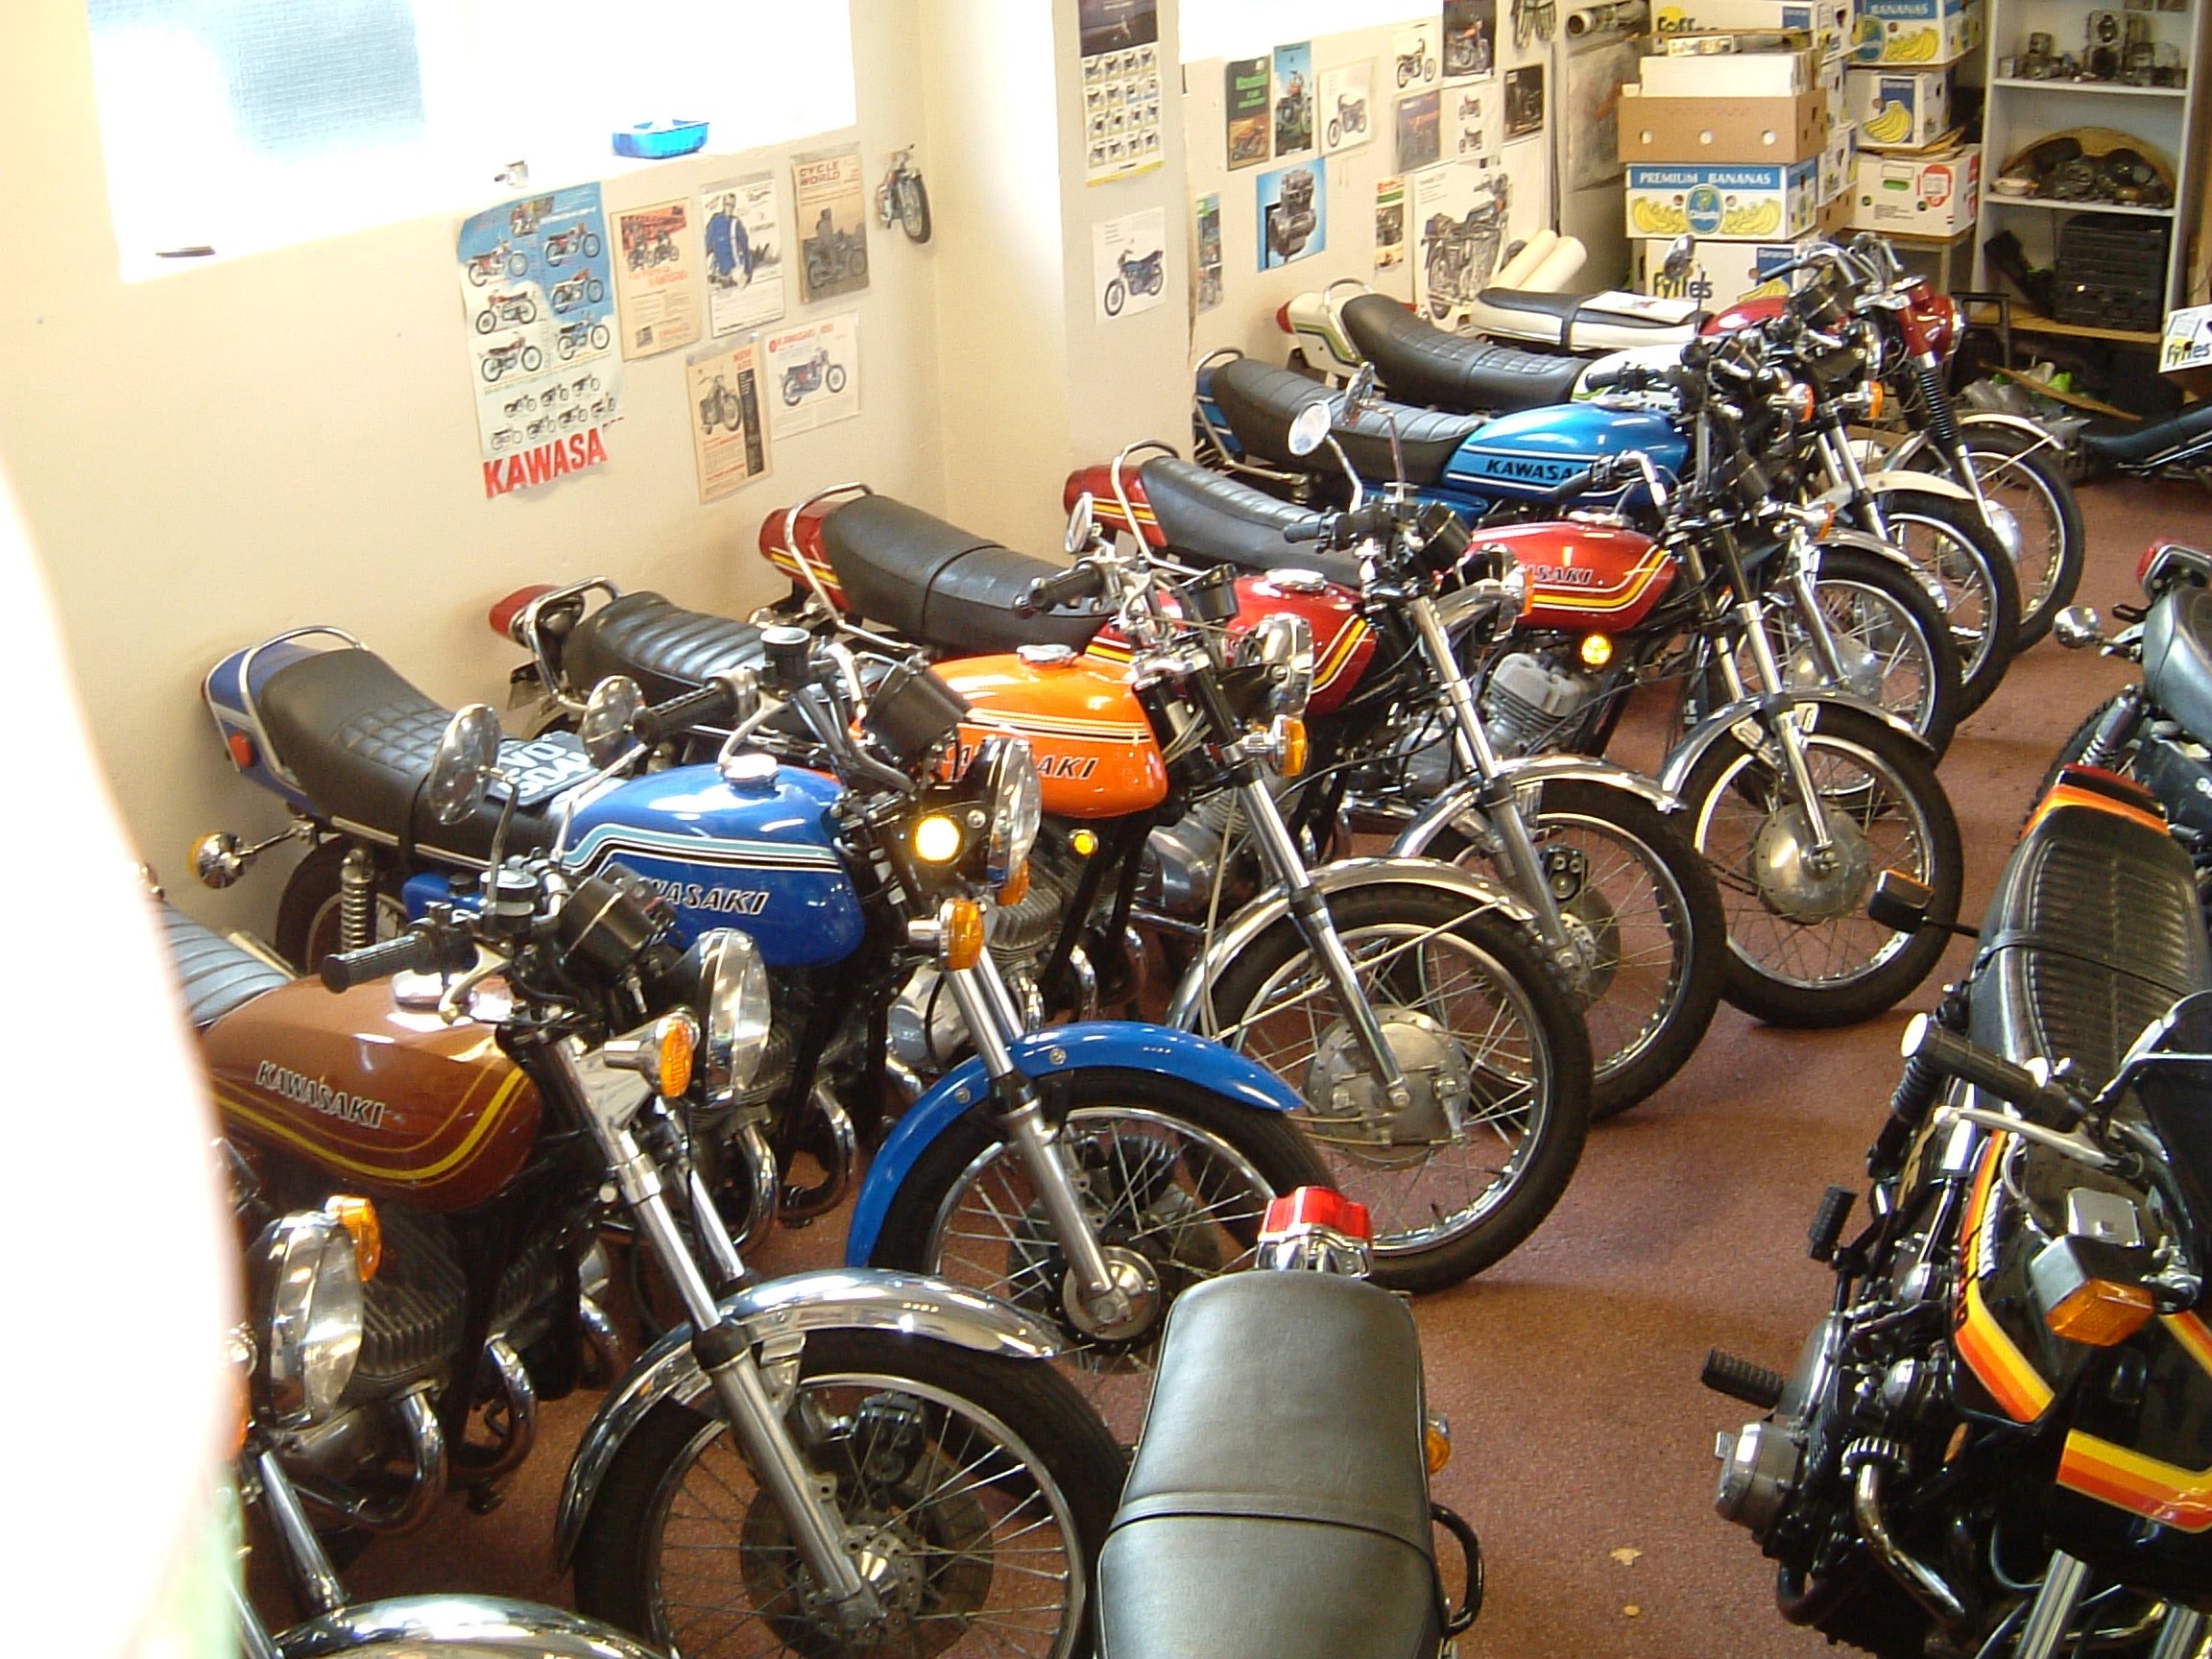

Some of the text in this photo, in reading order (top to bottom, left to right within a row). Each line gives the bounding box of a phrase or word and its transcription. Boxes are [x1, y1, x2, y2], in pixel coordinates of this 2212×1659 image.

[1869, 4, 1930, 15] BANANAS
[1639, 172, 1772, 185] PREMIUM BANANAS
[482, 427, 609, 499] KAWASA
[254, 1060, 386, 1129] KAWASAKI
